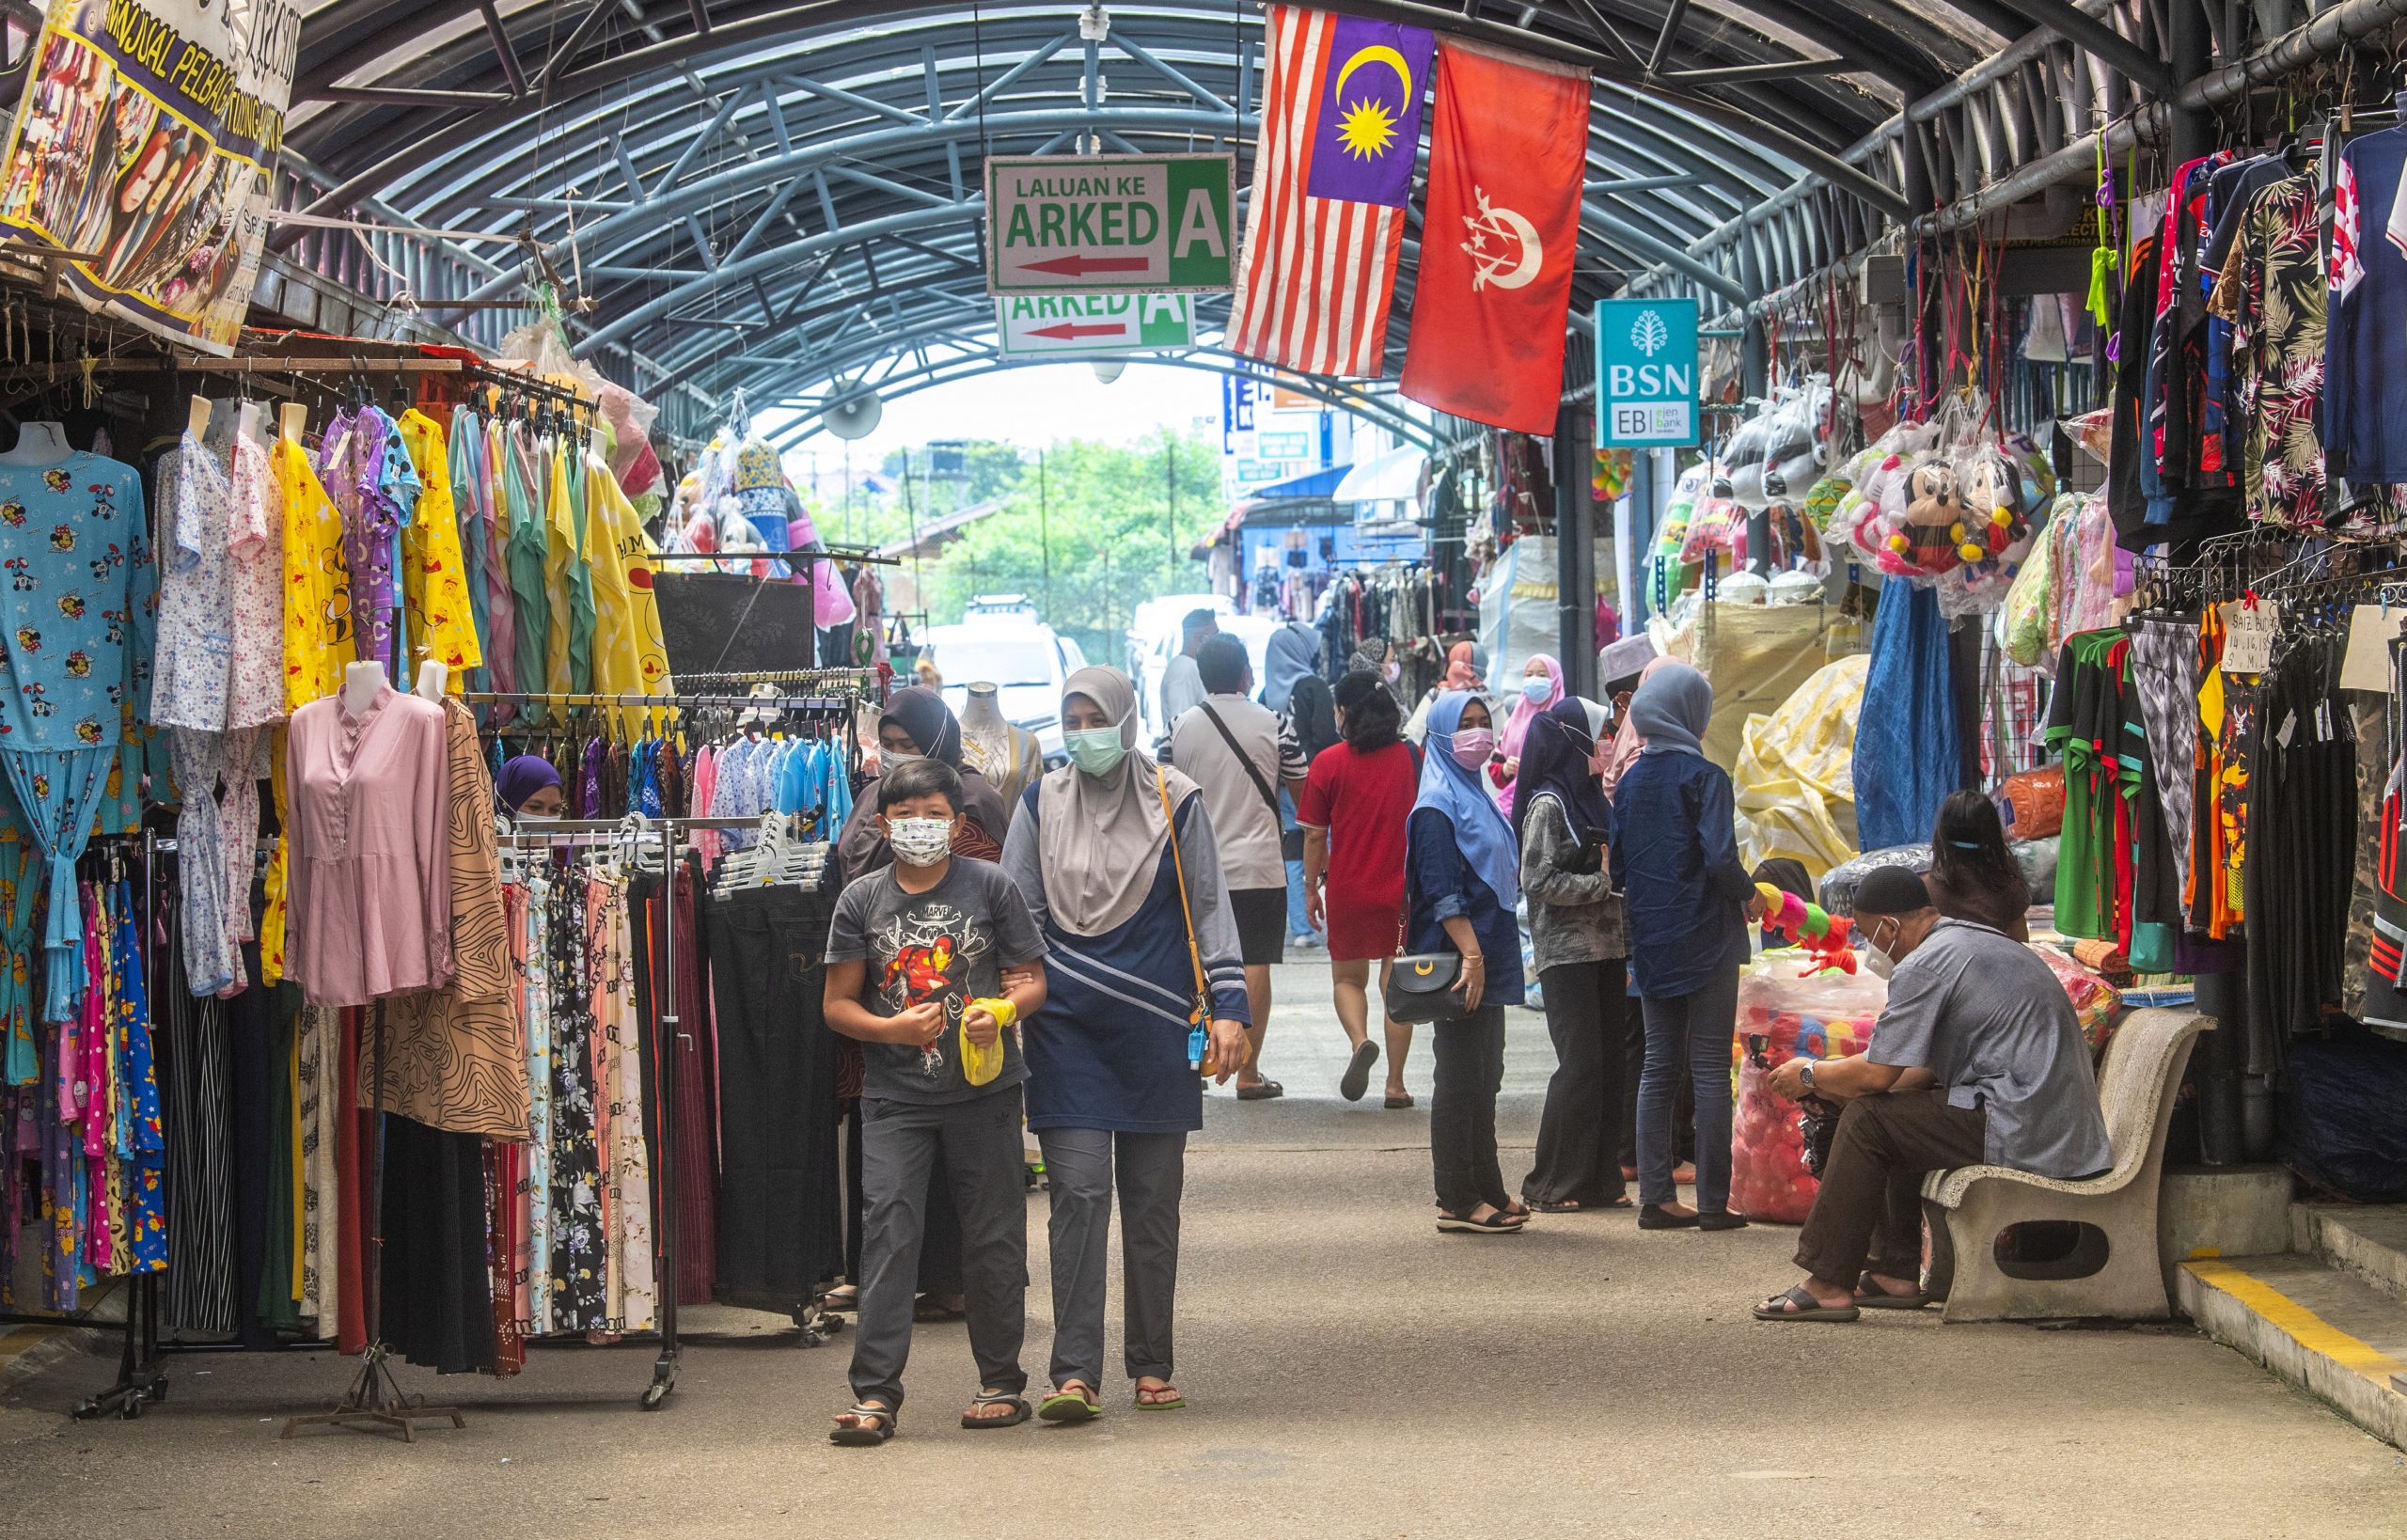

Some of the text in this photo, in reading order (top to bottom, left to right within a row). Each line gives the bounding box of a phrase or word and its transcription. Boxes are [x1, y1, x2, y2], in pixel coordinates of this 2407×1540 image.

[1016, 177, 1145, 197] LALUAN KE
[1005, 188, 1226, 259] ARKED A
[1012, 294, 1185, 324] ARKED A
[1610, 364, 1690, 396] BSN
[1618, 407, 1678, 433] EB ejen
[1656, 417, 1682, 428] bank
[2232, 614, 2253, 631] SAIZ
[923, 904, 952, 919] MARVE
